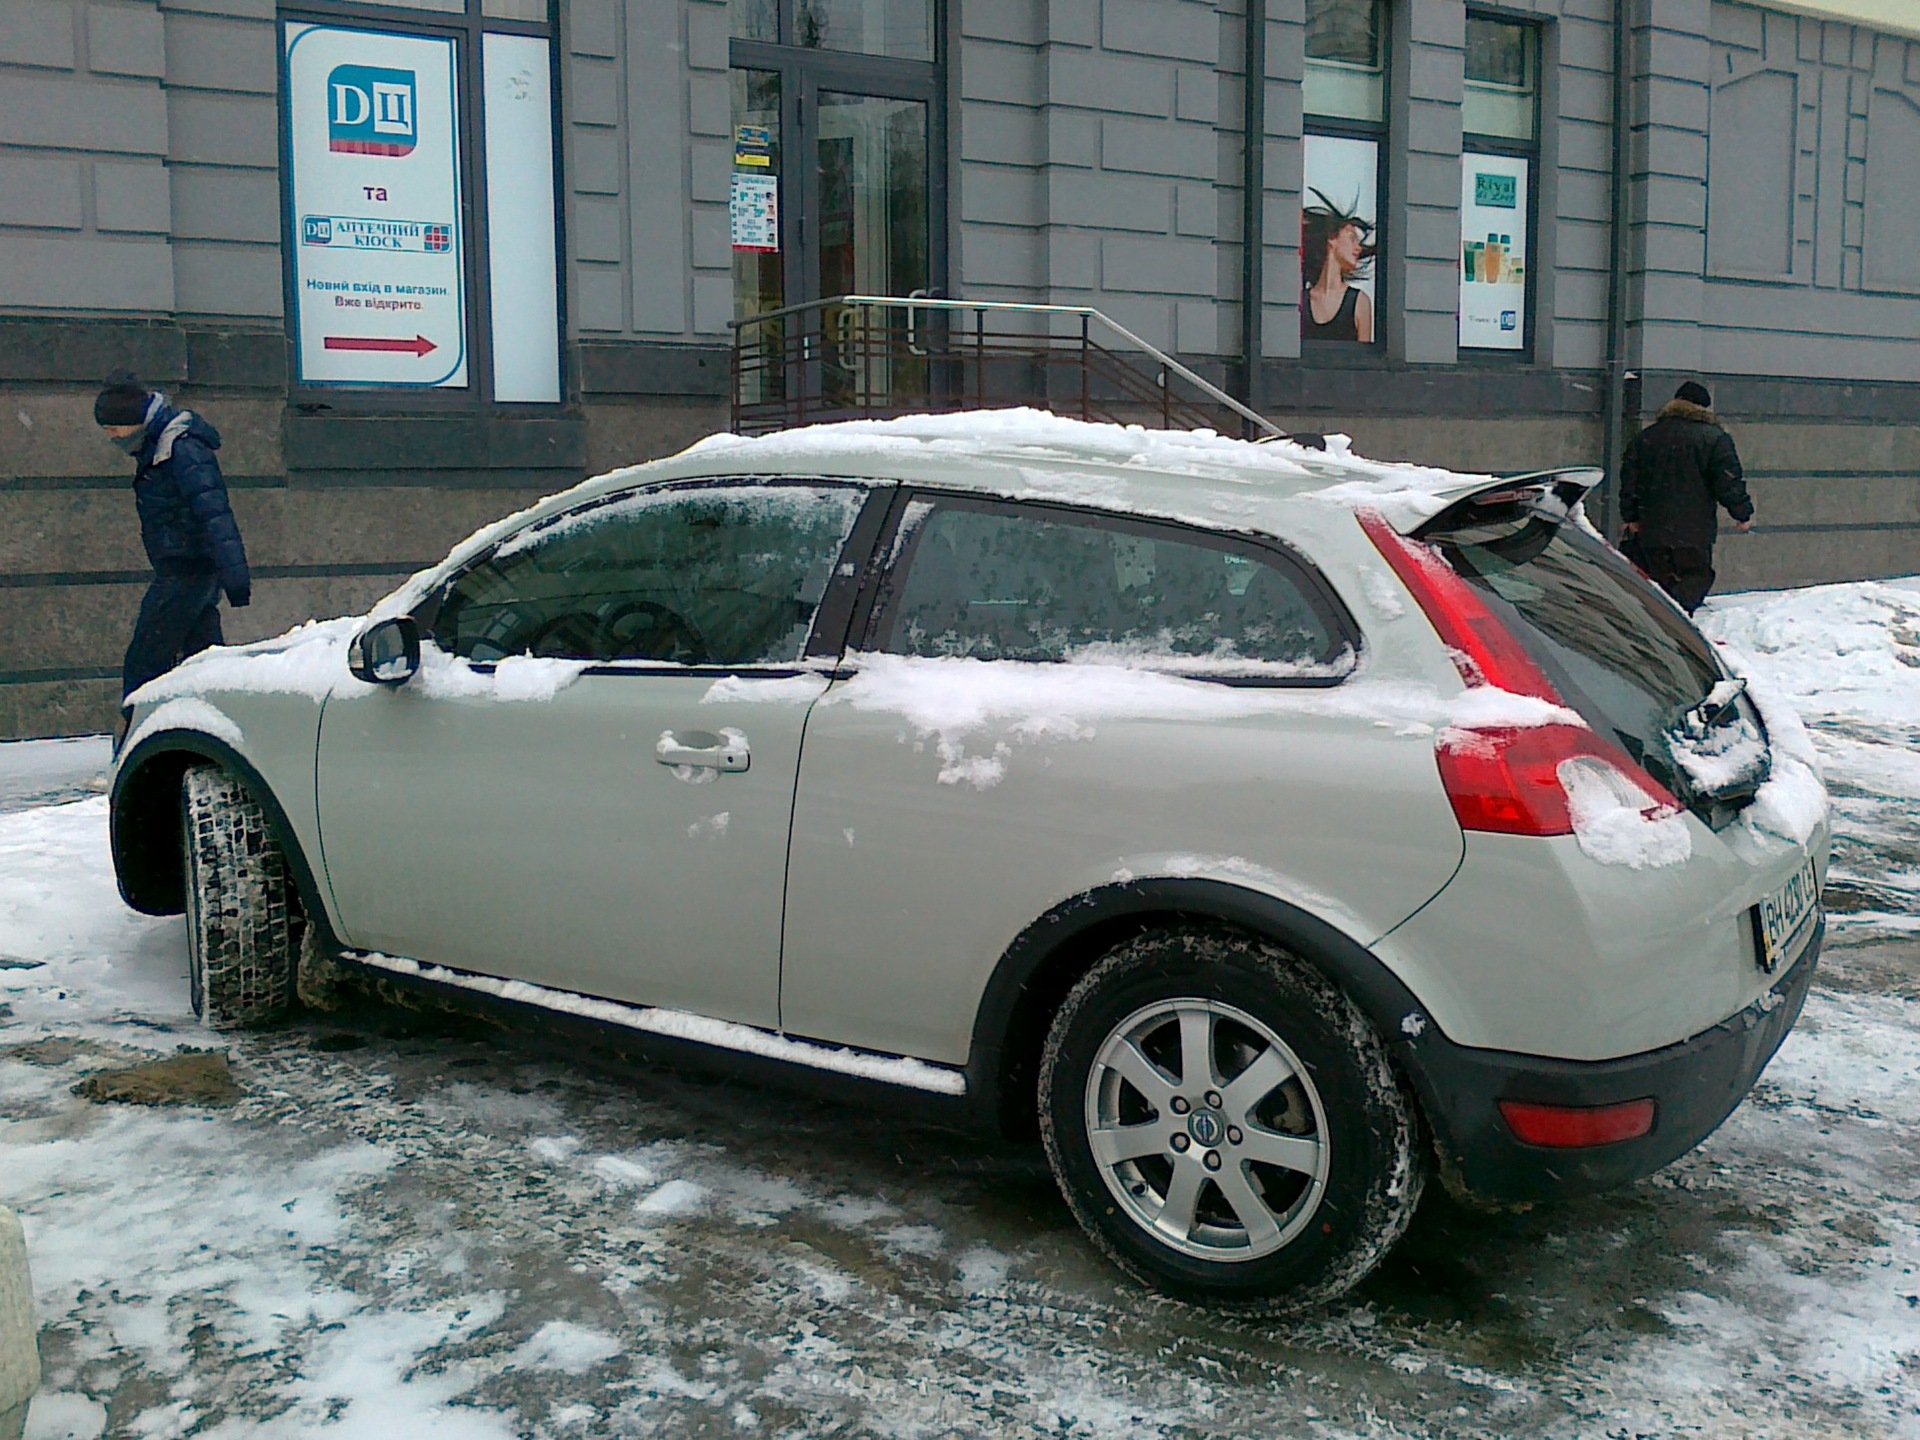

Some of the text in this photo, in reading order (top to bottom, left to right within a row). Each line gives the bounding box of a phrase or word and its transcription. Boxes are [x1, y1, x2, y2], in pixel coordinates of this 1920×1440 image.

[1477, 177, 1515, 194] Rival
[363, 186, 388, 202] та
[337, 221, 419, 237] АПТЕЧНИЙ
[355, 234, 402, 248] КІОСК
[306, 278, 350, 291] Новий
[353, 280, 381, 294] вхід
[384, 284, 392, 293] в
[335, 295, 362, 306] Вже
